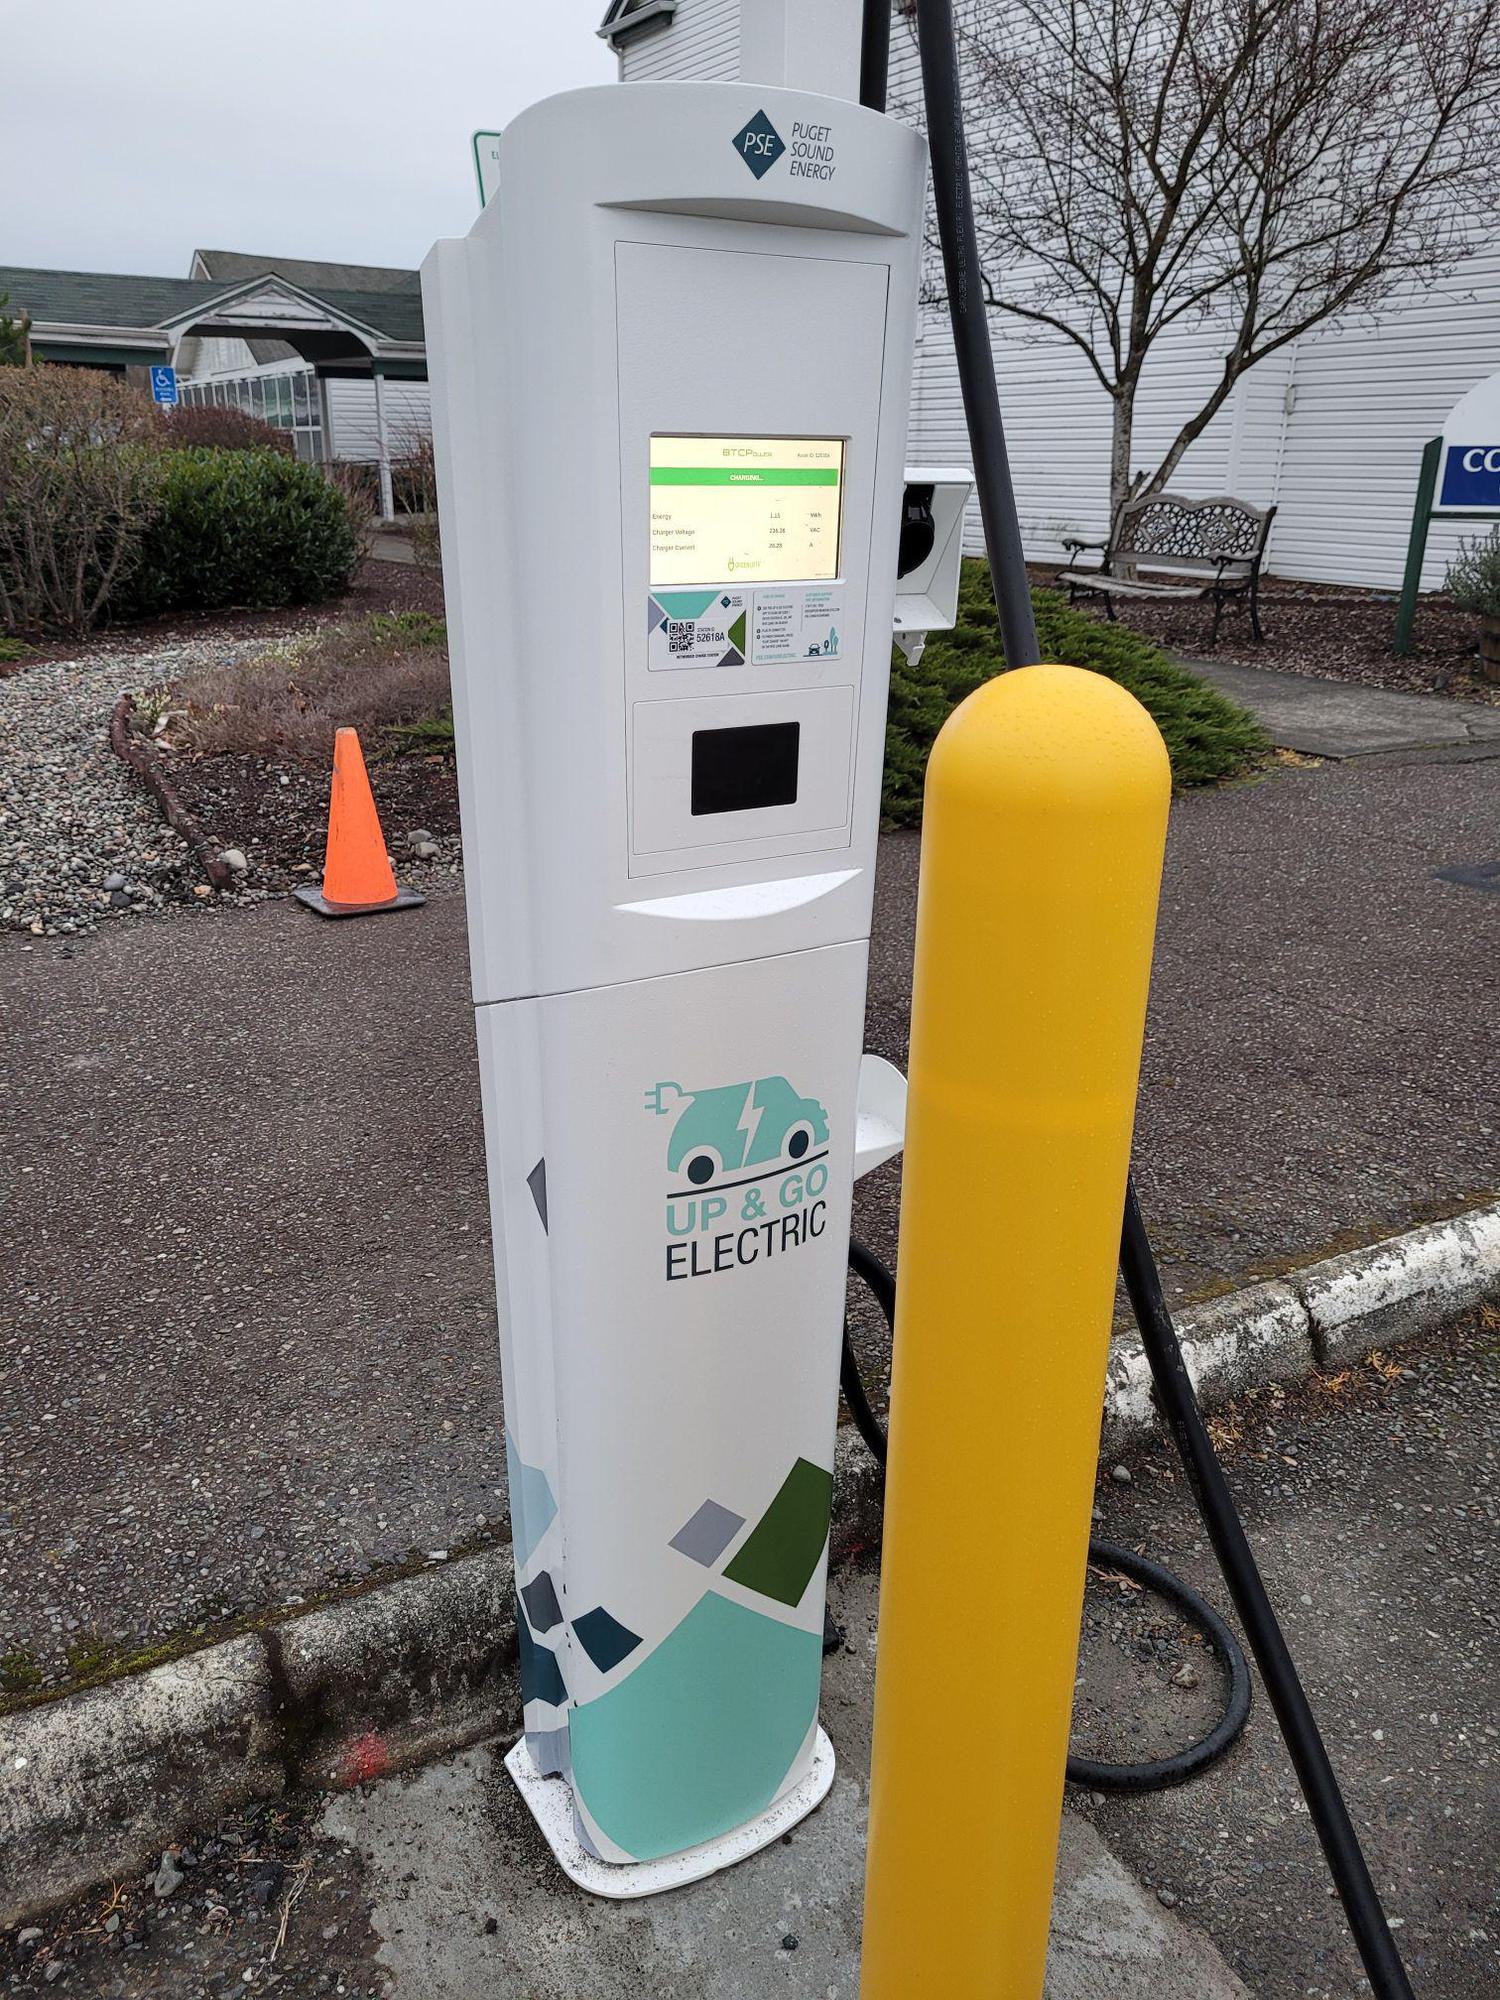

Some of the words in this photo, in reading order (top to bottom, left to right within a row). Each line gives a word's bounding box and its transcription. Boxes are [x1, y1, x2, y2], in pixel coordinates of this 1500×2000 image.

[791, 122, 832, 143] PUGET
[743, 132, 776, 157] PSE
[790, 141, 834, 162] SOUND
[789, 160, 836, 181] ENERGY
[652, 513, 672, 521] Energy
[652, 529, 674, 537] Charger
[696, 632, 725, 643] 52618A
[666, 1197, 727, 1236] UP
[740, 1187, 767, 1221] &
[779, 1163, 828, 1208] GO
[666, 1200, 827, 1281] ELECTRIC
